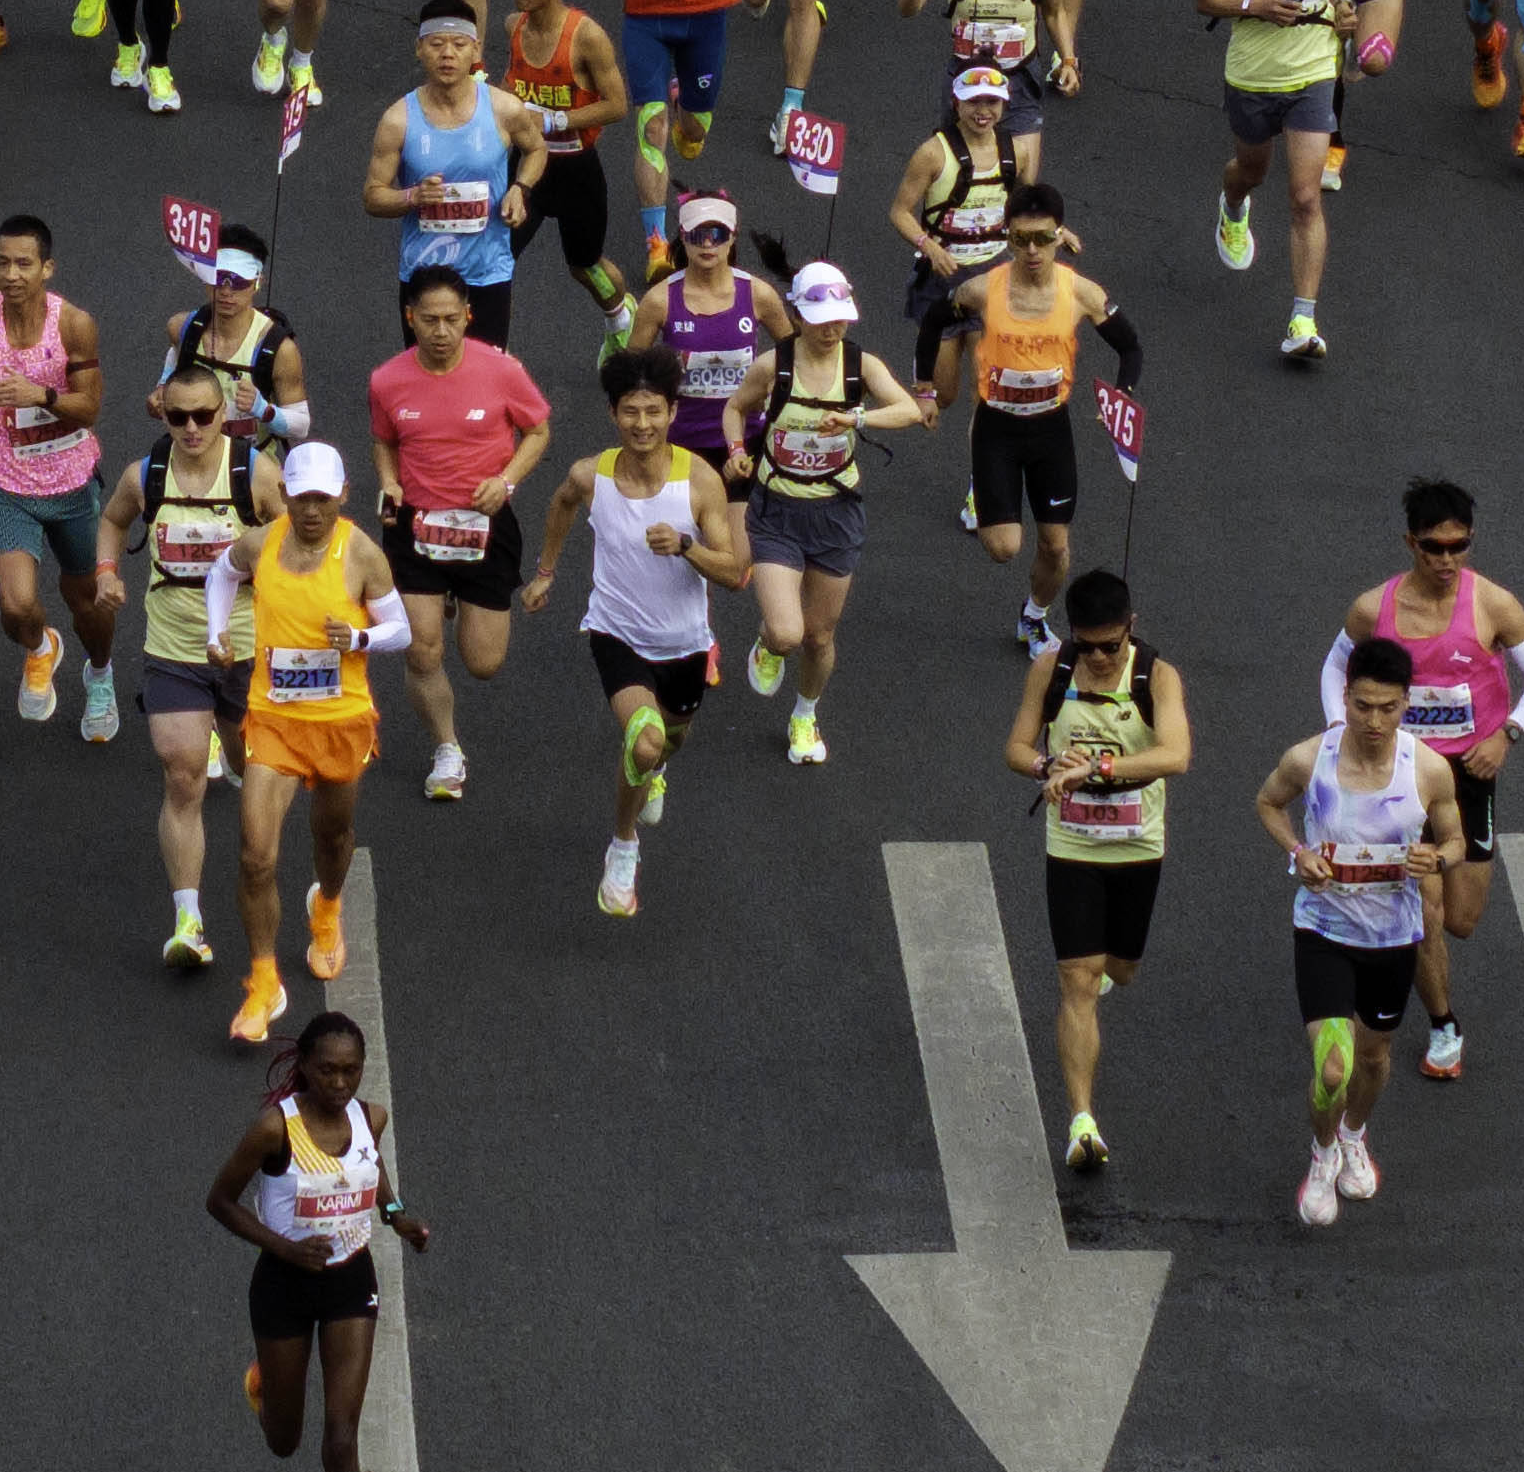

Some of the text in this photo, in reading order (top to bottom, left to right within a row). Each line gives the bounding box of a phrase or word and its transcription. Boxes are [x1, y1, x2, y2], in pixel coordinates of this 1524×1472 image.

[790, 115, 834, 165] 3:30
[168, 204, 213, 253] 3:15
[688, 366, 747, 388] 60499
[791, 450, 828, 468] 202
[272, 666, 333, 689] 52217
[1406, 704, 1468, 726] 52223
[1082, 803, 1120, 823] 103
[315, 1191, 363, 1212] KARIMI
